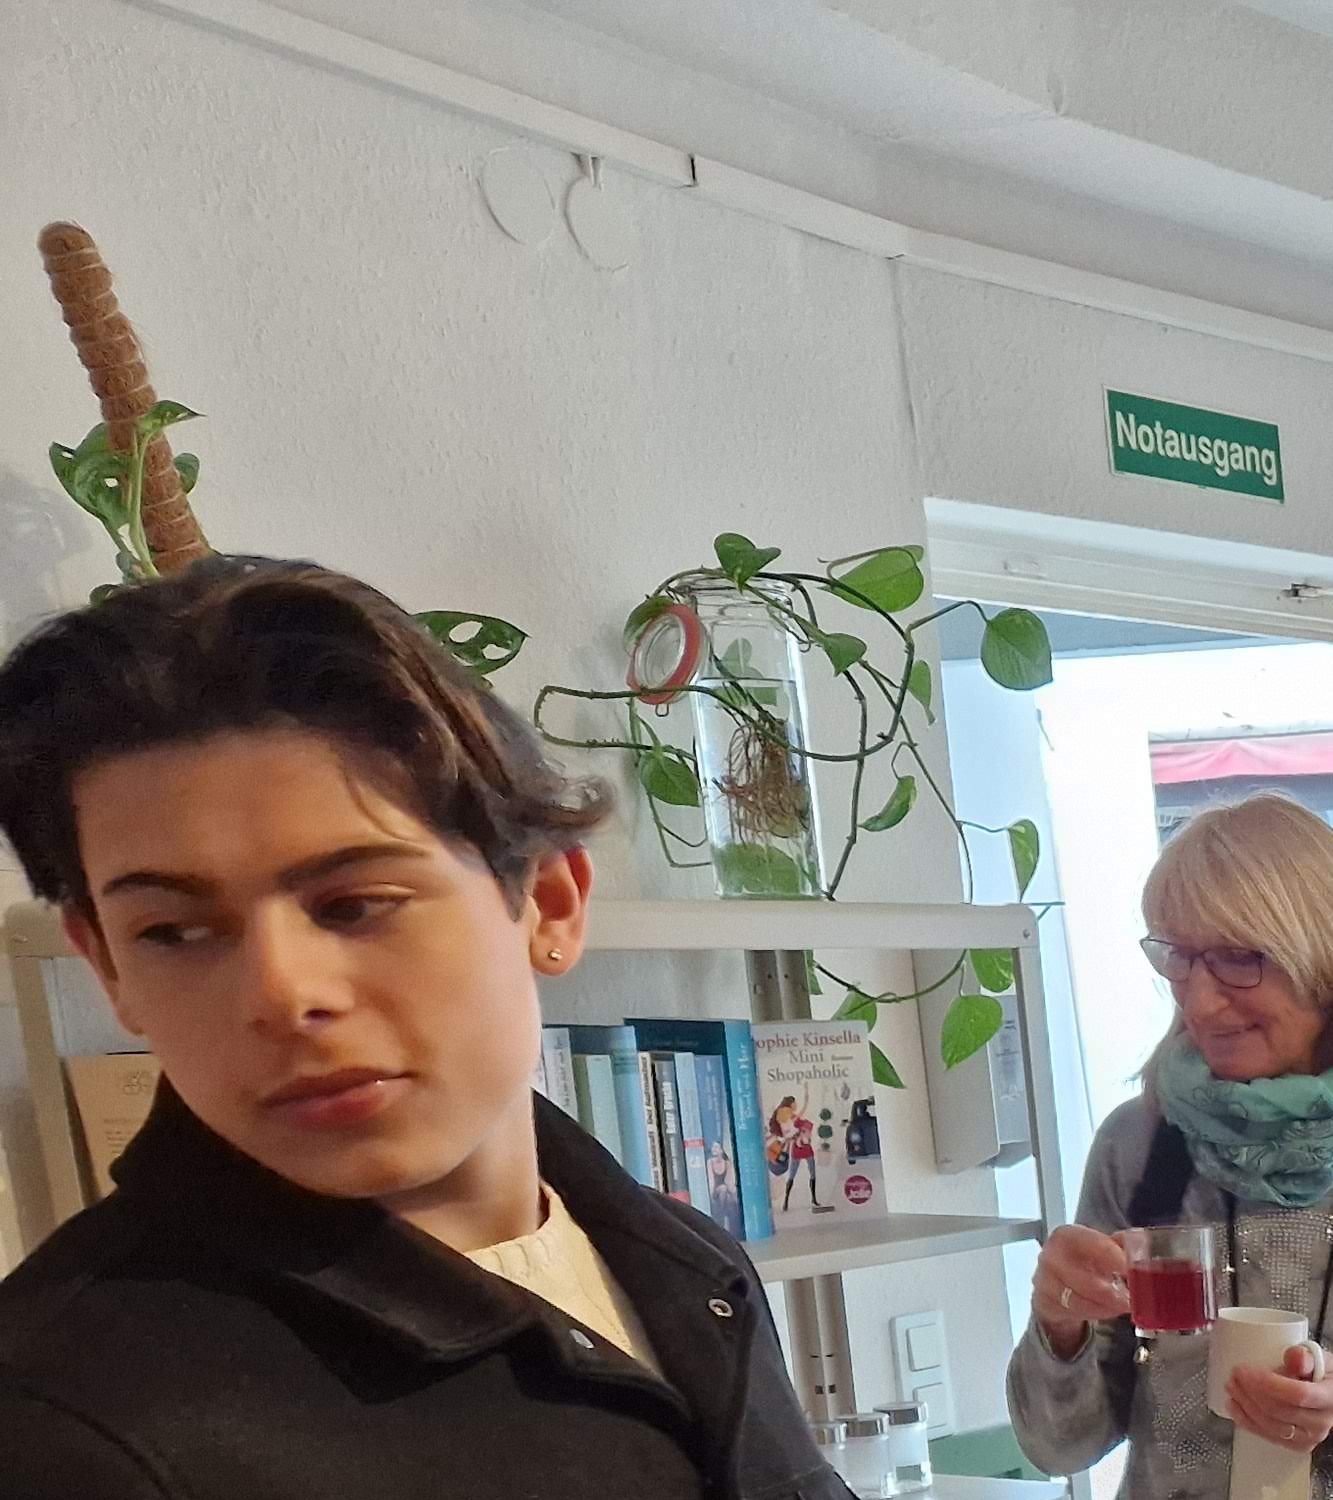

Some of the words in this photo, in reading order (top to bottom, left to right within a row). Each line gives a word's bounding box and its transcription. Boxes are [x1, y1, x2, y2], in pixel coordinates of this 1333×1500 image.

[1115, 410, 1278, 486] Notausgang
[756, 1032, 800, 1052] ophie
[802, 1030, 861, 1047] Kinsella
[788, 1048, 825, 1063] Mini
[767, 1064, 850, 1083] Shopaholic
